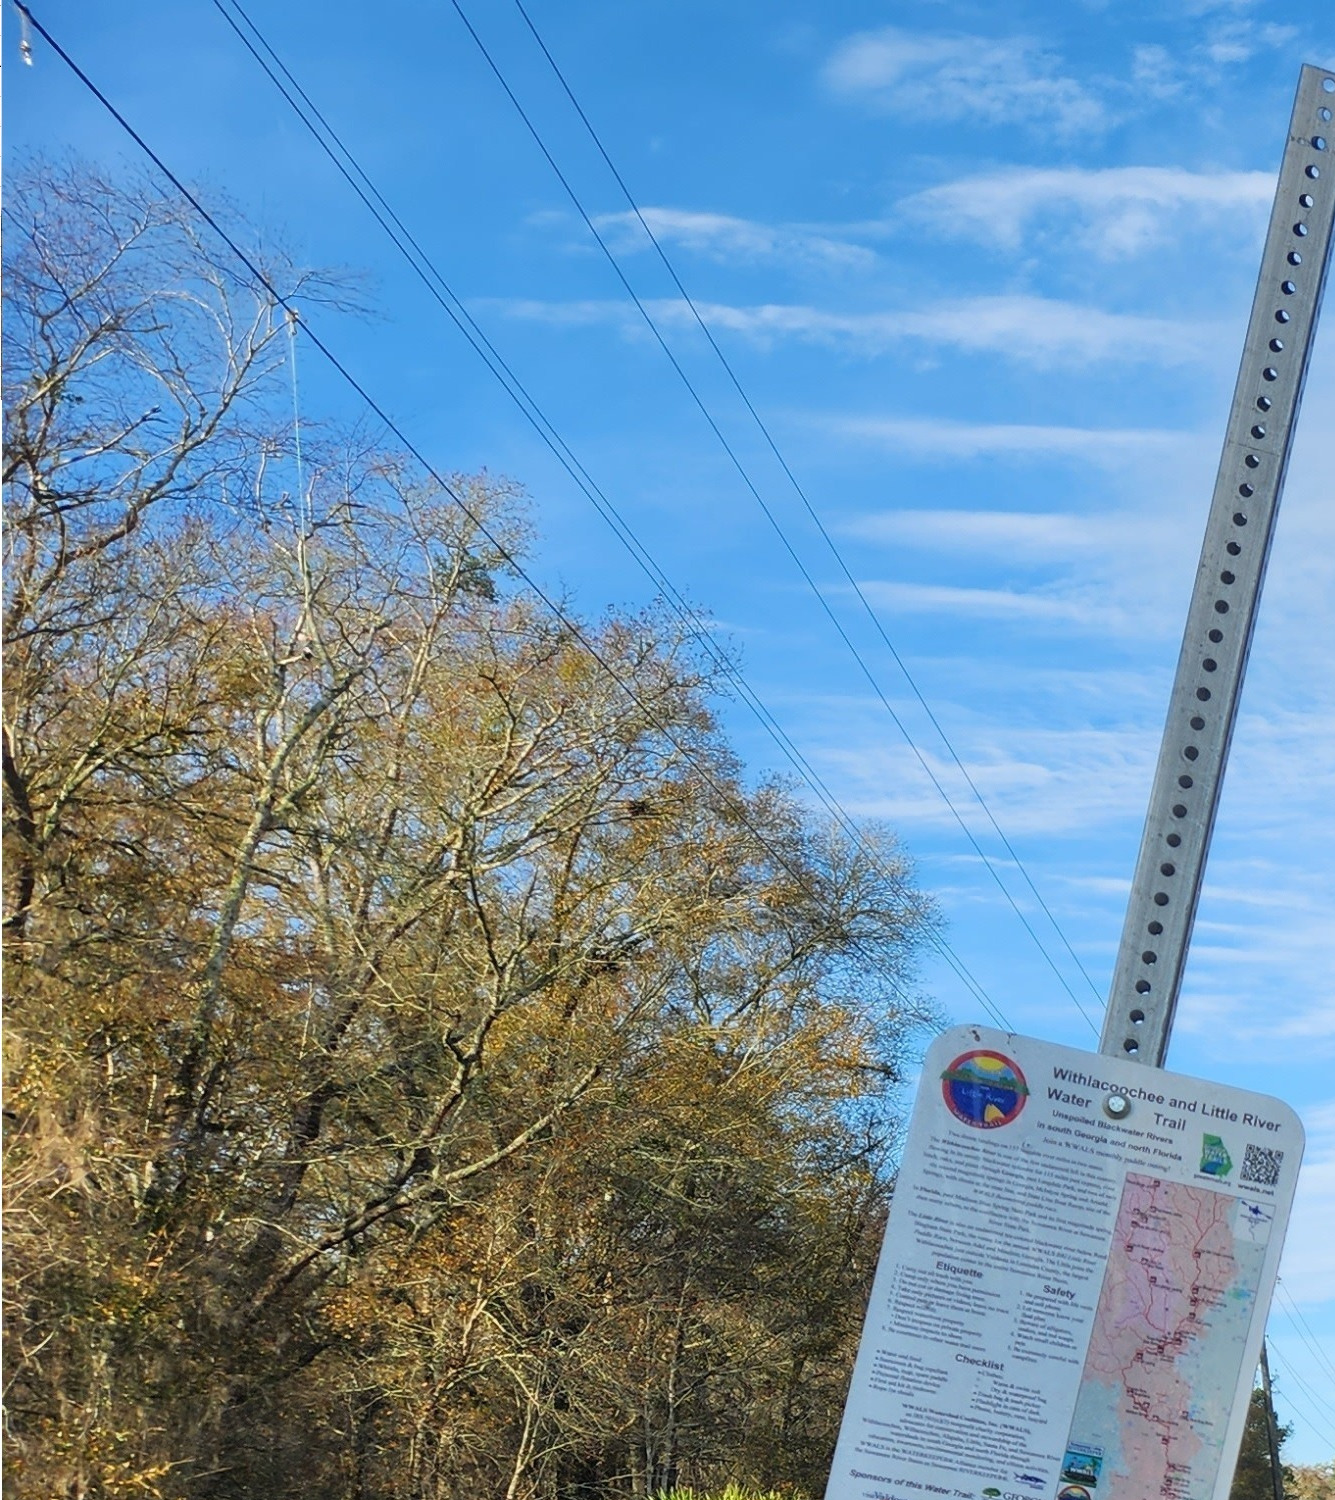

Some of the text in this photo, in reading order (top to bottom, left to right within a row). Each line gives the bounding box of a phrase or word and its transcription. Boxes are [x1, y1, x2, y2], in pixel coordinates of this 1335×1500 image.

[1046, 1086, 1186, 1130] Water Trail
[1051, 1066, 1281, 1132] Withlacoochee and Little River
[1036, 1120, 1182, 1161] in south Georgia and north Florida
[1051, 1109, 1174, 1144] Unspoiled Blackwater Rivers
[935, 1261, 983, 1279] Etiquette
[1042, 1284, 1076, 1300] Safety
[954, 1353, 1004, 1371] Checklist
[848, 1468, 975, 1499] Sponsors of this Water Trail:
